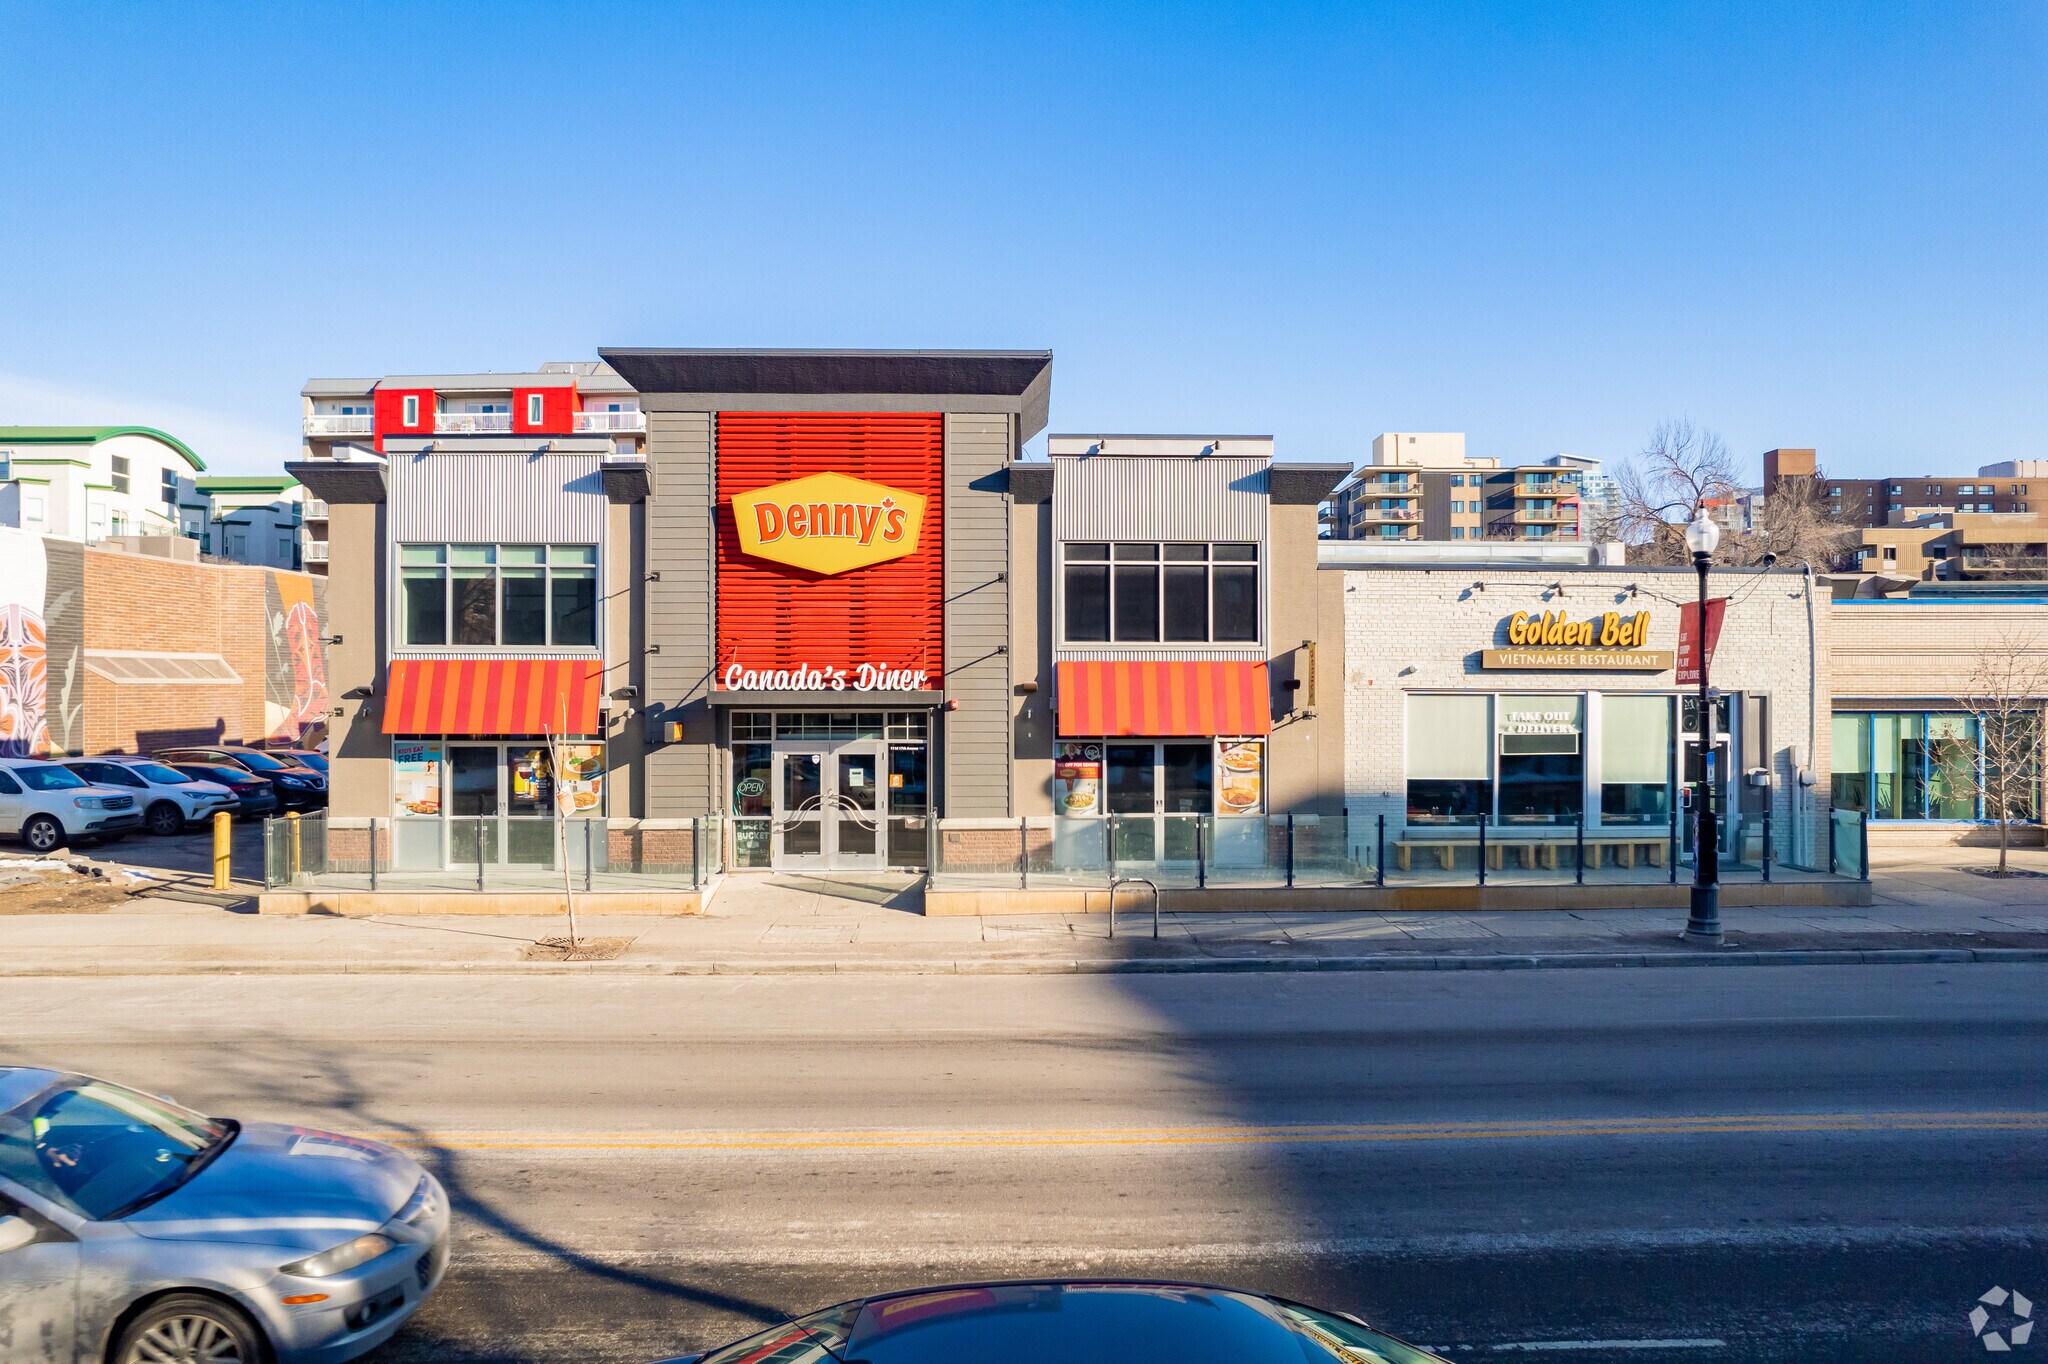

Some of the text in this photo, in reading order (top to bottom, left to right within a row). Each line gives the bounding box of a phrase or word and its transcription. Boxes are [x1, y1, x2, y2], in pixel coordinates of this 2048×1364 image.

[752, 497, 907, 546] Denny's
[1508, 609, 1651, 648] Golden Bell
[1499, 653, 1659, 667] VIETNAMESE RESTAURANT
[1678, 658, 1690, 668] PLAY
[725, 662, 928, 692] Canada's Diner
[1677, 670, 1700, 680] EXPLORE
[1510, 711, 1571, 721] TAKE OUT
[1517, 724, 1576, 733] DELIVERY
[398, 753, 424, 764] FREE
[739, 782, 764, 792] OPEN
[736, 831, 770, 841] BUCKET
